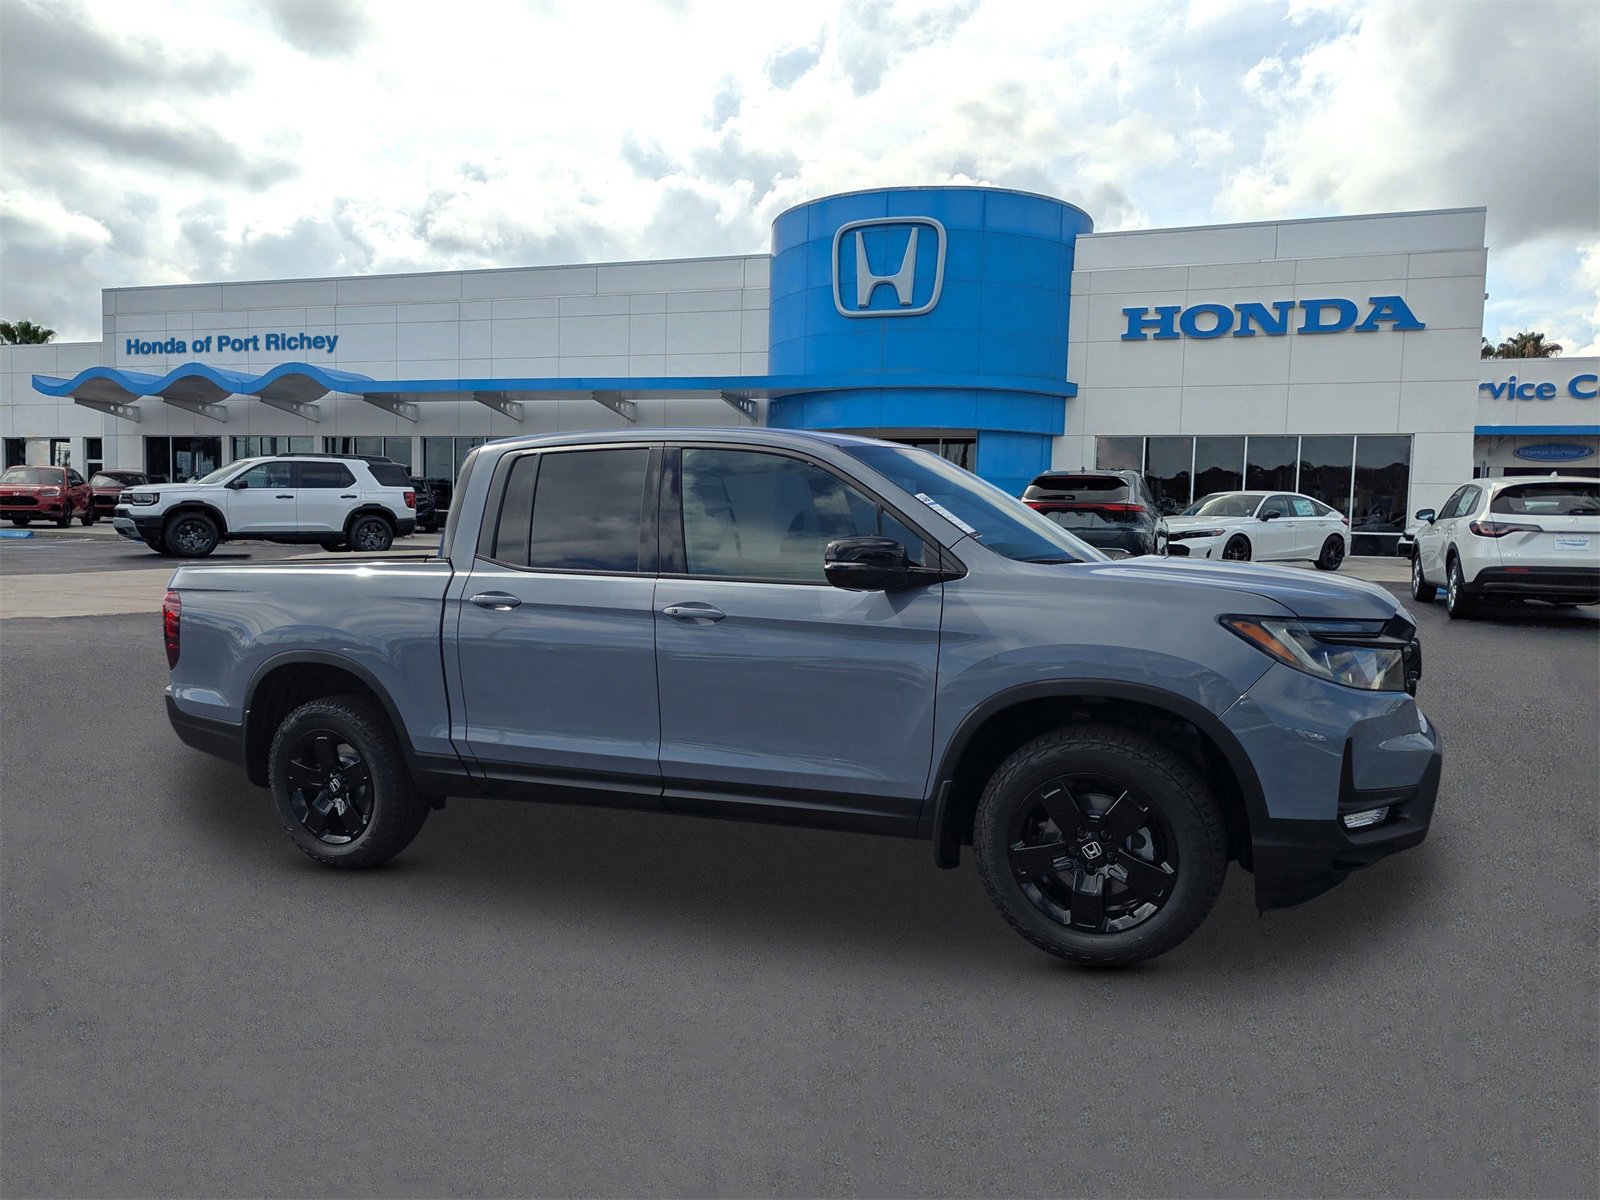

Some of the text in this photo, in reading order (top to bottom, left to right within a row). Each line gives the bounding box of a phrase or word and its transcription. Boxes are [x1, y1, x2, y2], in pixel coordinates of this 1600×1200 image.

[1121, 295, 1426, 341] HONDA
[126, 332, 339, 355] Honda of Port Richey
[1568, 374, 1600, 400] C
